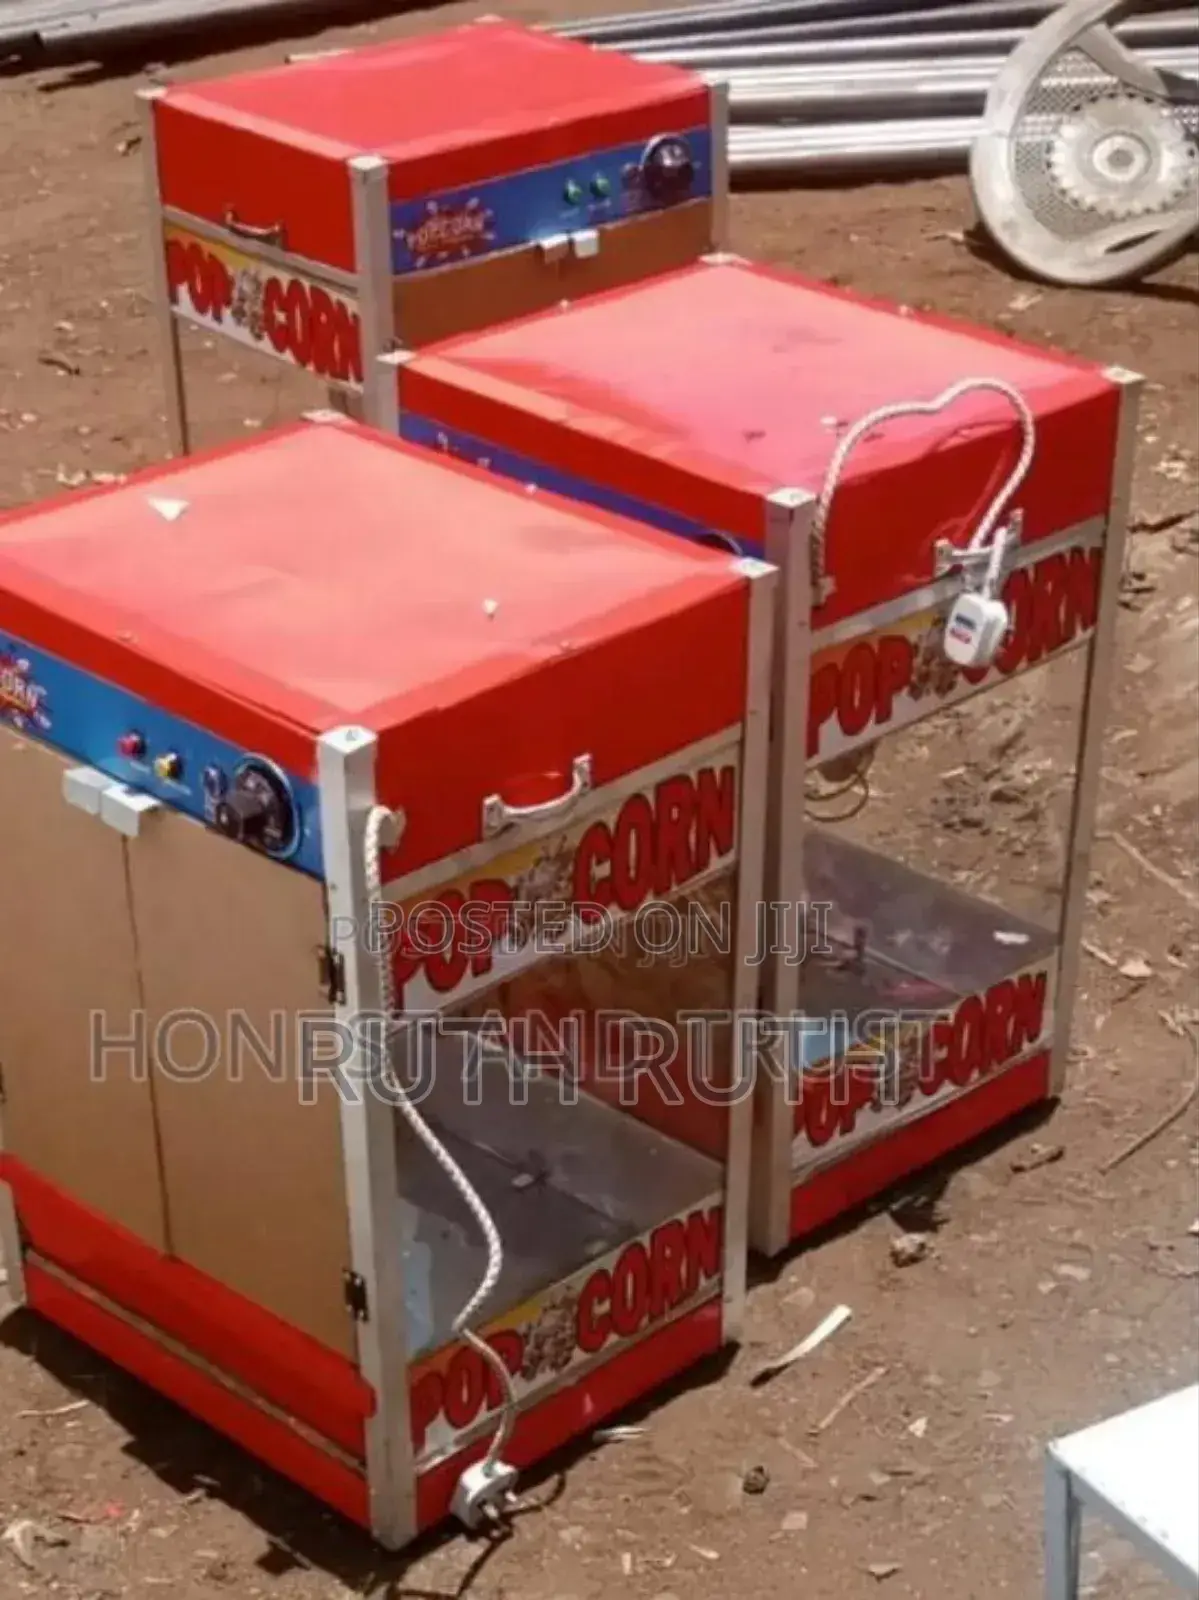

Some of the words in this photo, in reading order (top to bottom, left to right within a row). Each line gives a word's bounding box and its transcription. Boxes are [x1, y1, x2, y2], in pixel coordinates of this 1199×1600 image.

[165, 238, 235, 325] POP
[263, 276, 364, 383] CORN
[804, 635, 914, 758] POP
[962, 547, 1104, 686] ORN
[384, 876, 517, 1019] POP
[573, 767, 735, 925] CORN
[917, 971, 1047, 1096] CORN
[409, 1330, 523, 1456] POP
[576, 1205, 723, 1352] CORN
